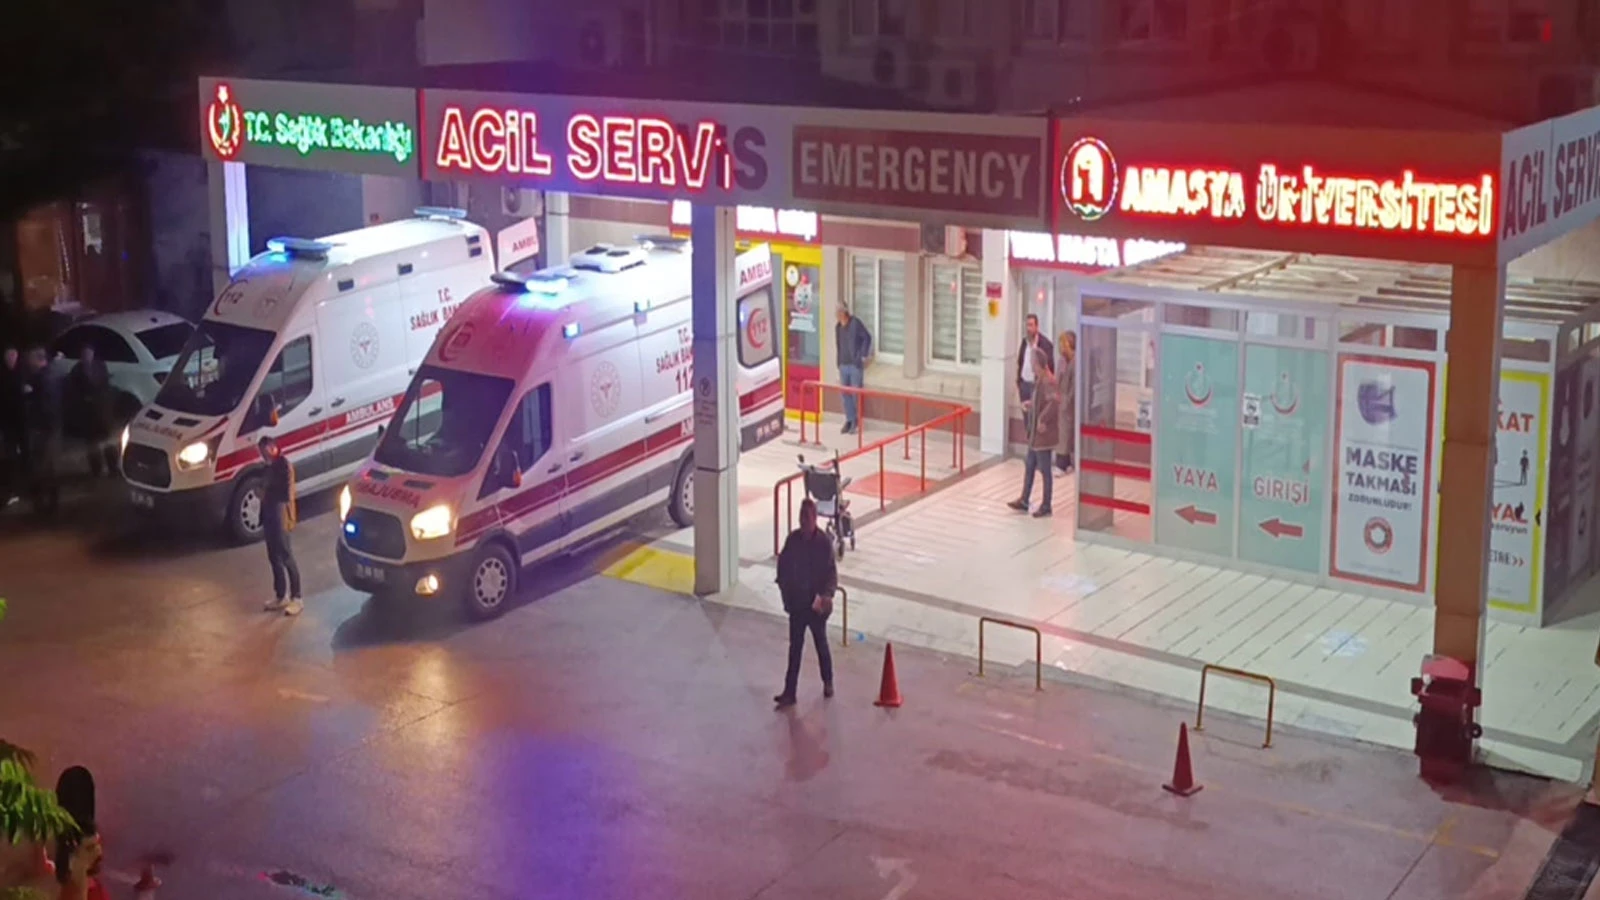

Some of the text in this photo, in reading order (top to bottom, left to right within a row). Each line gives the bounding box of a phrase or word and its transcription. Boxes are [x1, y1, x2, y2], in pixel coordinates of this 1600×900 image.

[800, 141, 1031, 200] EMERGENCY
[1120, 165, 1246, 219] AMASYA
[1497, 411, 1535, 433] KAT
[1346, 446, 1419, 475] MASKE
[1173, 465, 1219, 493] YAYA
[1345, 470, 1418, 497] TAKMASI
